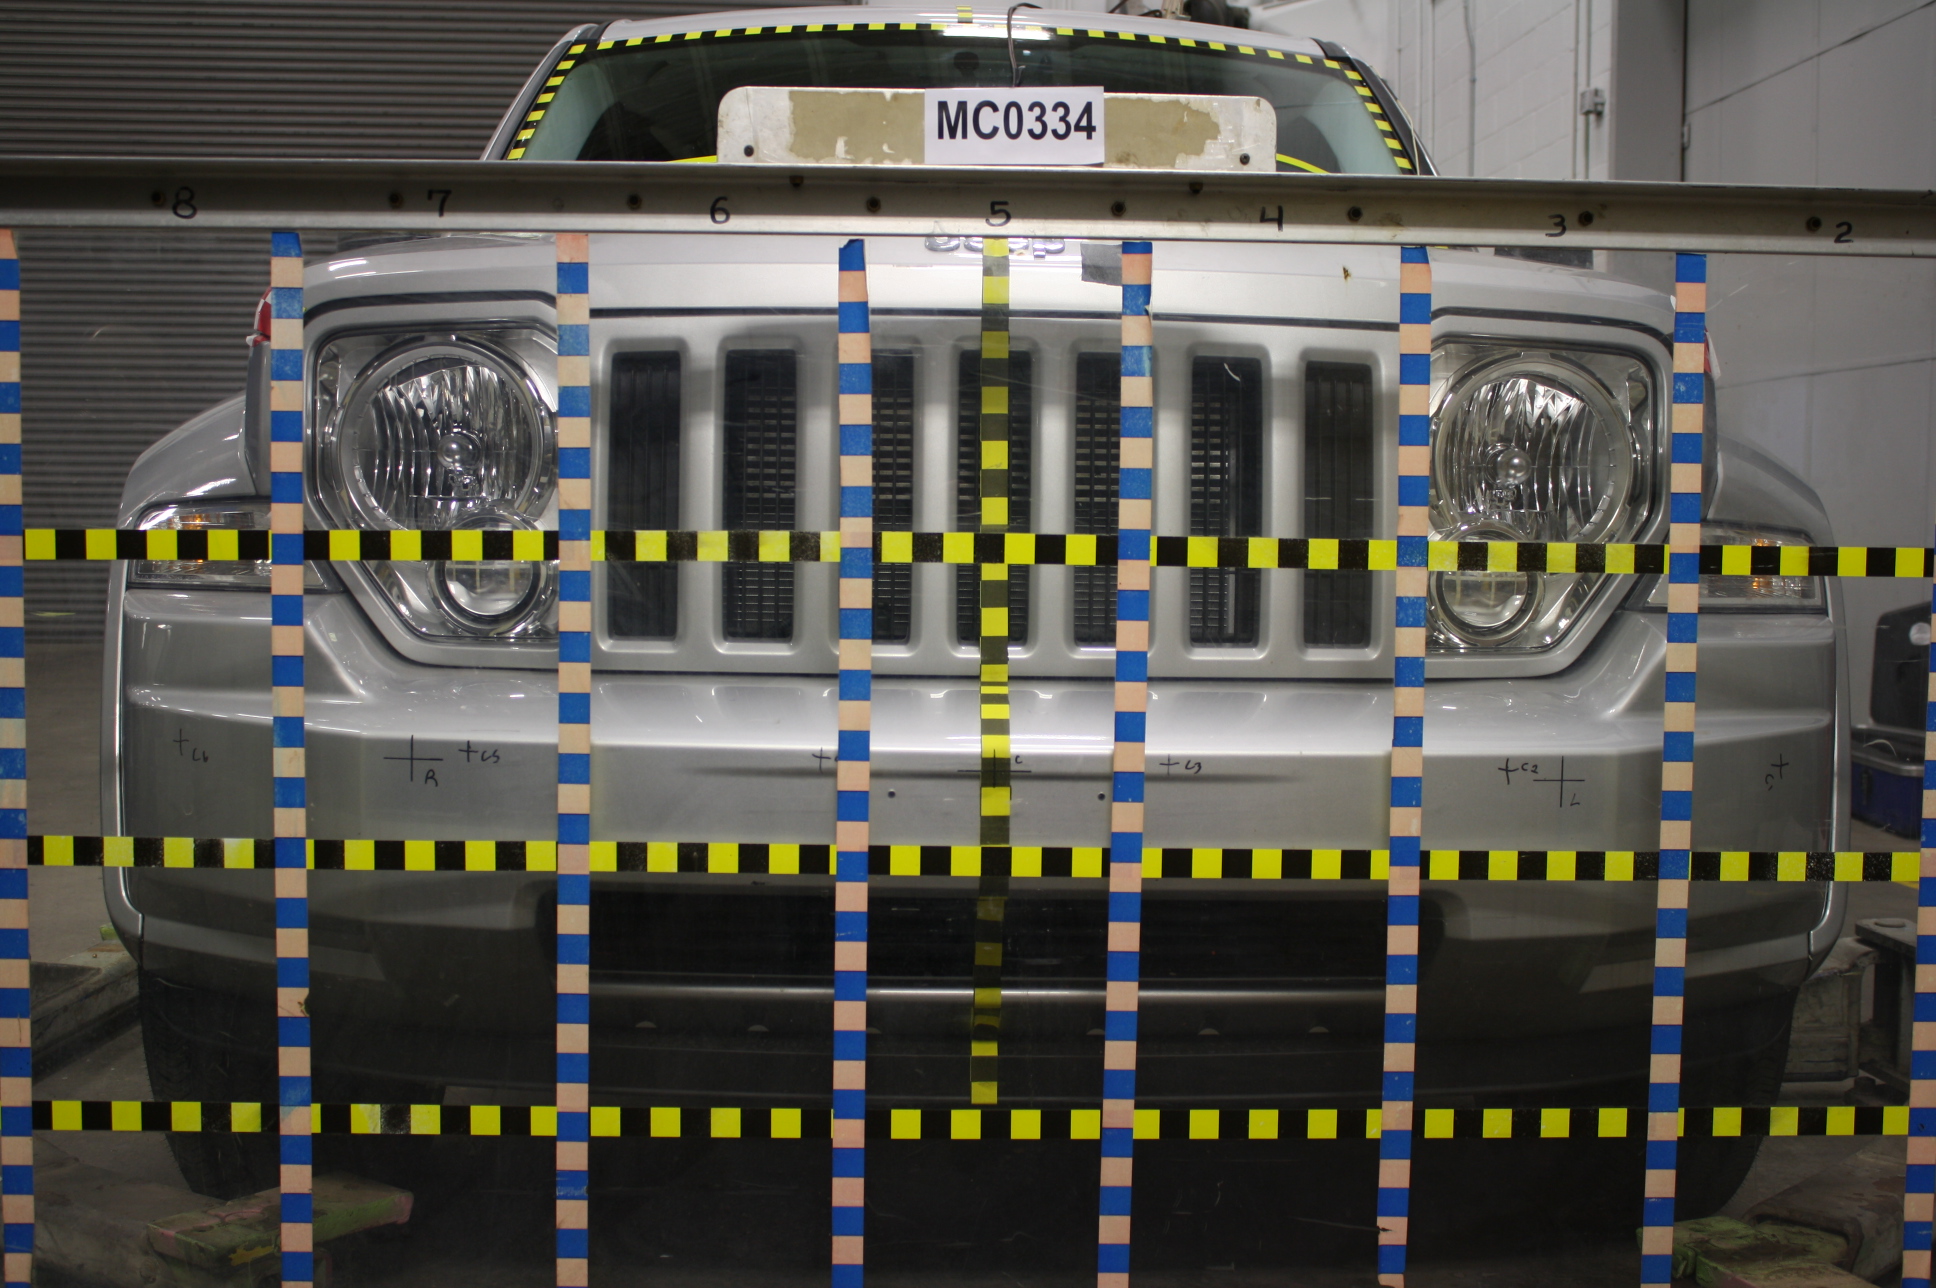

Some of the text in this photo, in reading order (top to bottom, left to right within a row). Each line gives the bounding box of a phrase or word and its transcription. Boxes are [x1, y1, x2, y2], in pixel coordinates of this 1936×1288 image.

[937, 100, 1096, 141] MC0334
[172, 186, 198, 219] 8
[427, 189, 452, 218] 7
[710, 196, 731, 225] 6
[985, 201, 1012, 227] 5
[1260, 205, 1283, 232] 4
[1545, 213, 1567, 238] 3
[1834, 221, 1854, 244] 2
[425, 769, 438, 787] R
[1521, 762, 1539, 774] C2
[1569, 793, 1581, 807] L
